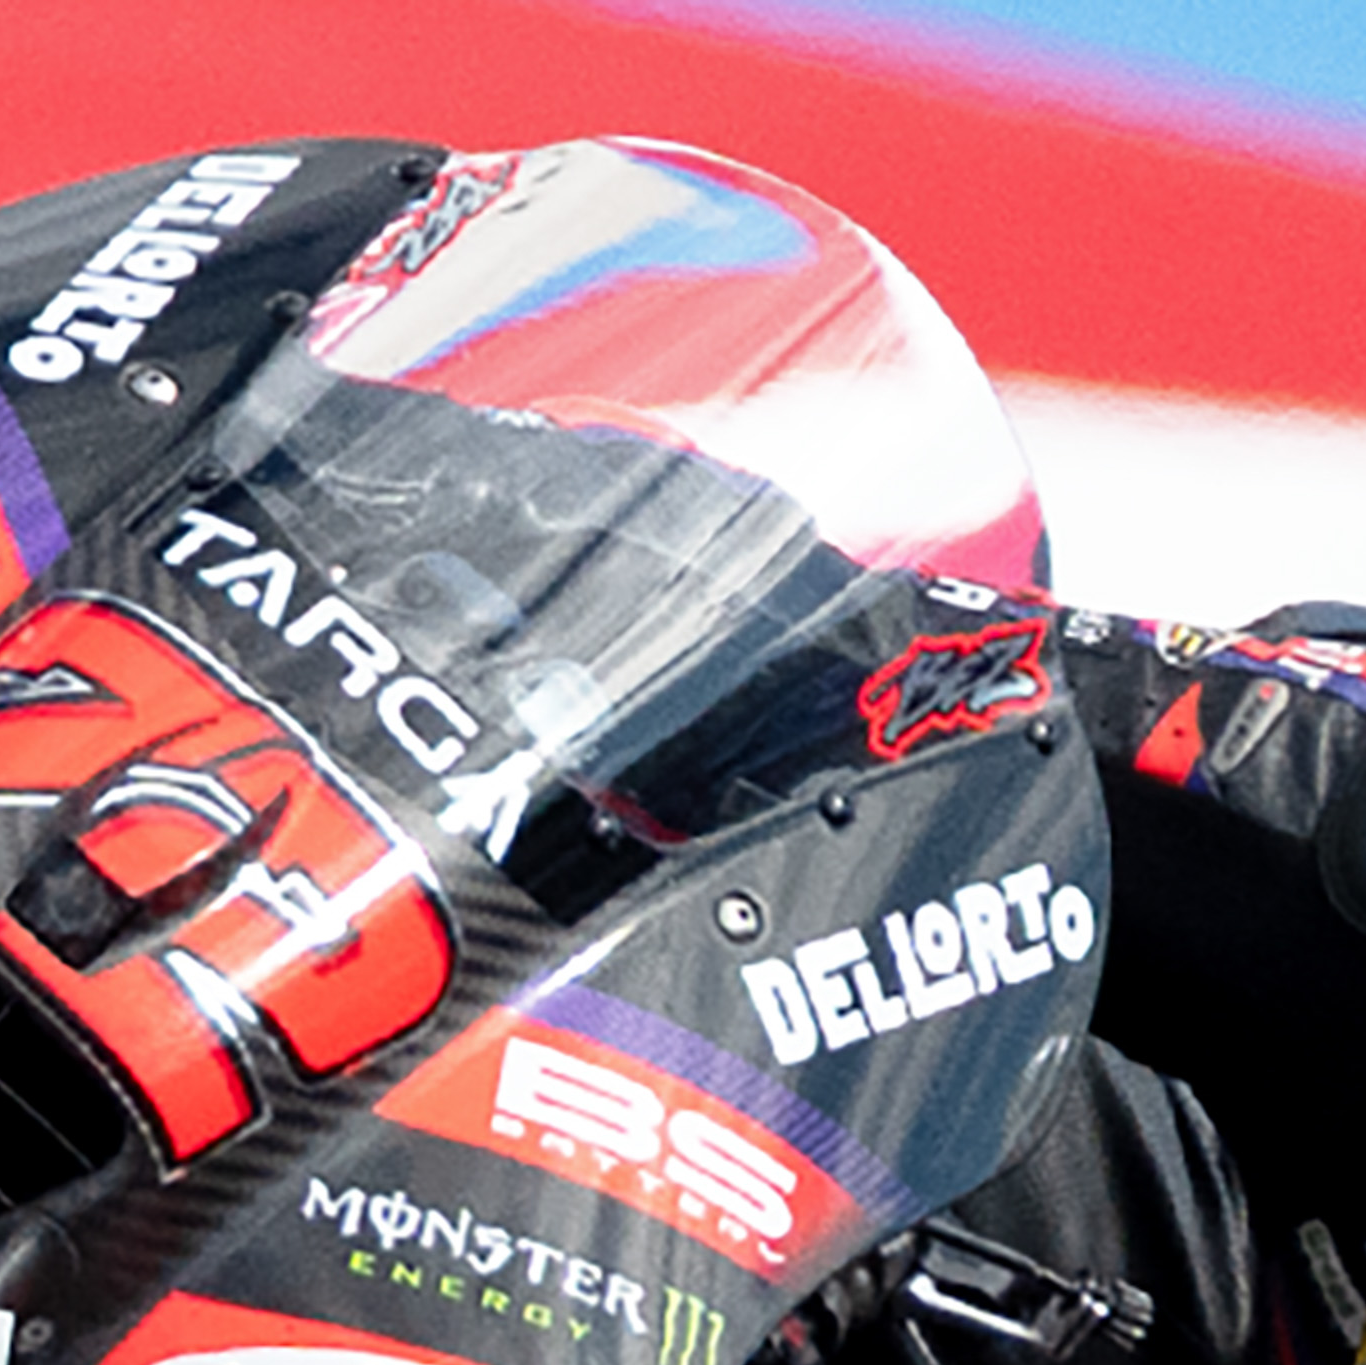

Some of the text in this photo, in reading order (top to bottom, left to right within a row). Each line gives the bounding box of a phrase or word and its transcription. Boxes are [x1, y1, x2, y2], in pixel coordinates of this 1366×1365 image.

[162, 508, 537, 864] TARGA
[740, 863, 1095, 1066] DELLORTO
[492, 1036, 797, 1239] BS
[300, 1177, 650, 1334] MONSTER
[348, 1249, 592, 1342] ENERGY
